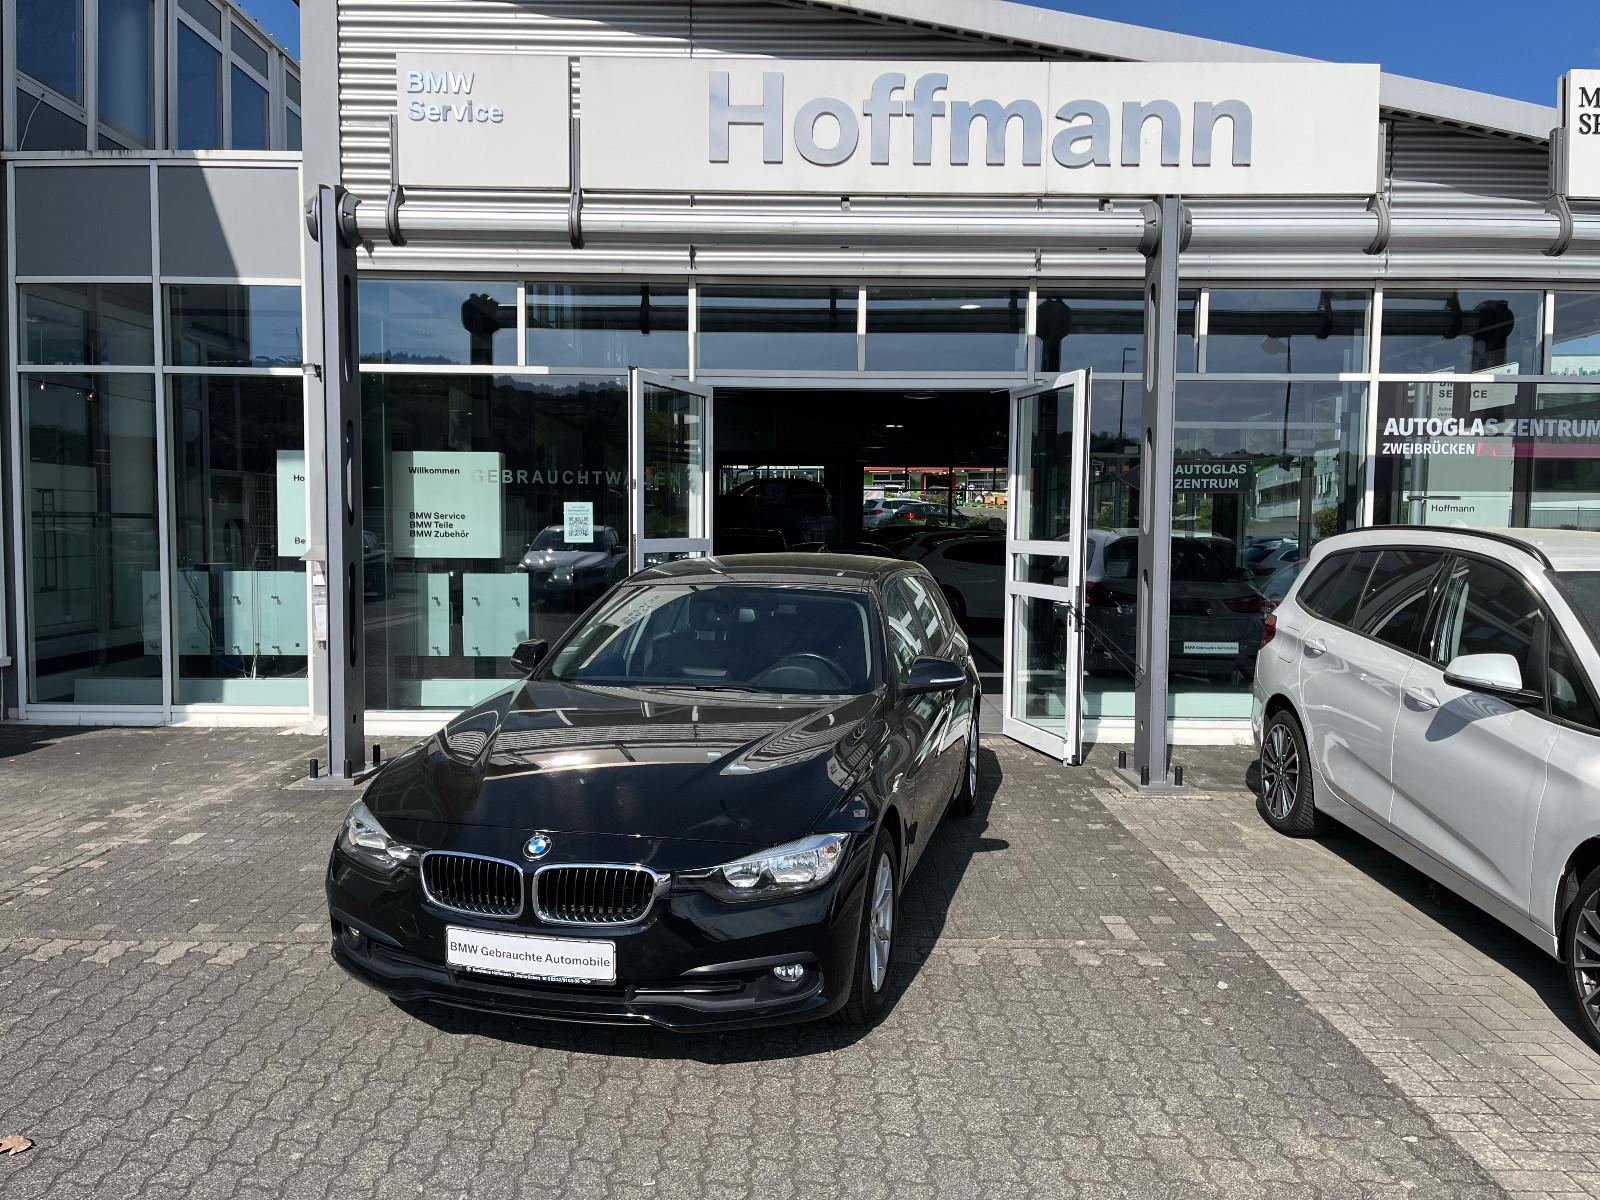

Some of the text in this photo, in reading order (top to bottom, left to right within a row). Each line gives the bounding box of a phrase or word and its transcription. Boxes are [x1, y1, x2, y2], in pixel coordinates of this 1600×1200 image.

[406, 70, 475, 94] BMW
[408, 100, 504, 123] Service
[708, 71, 1253, 168] Hoffmann
[1383, 417, 1600, 437] AUTOGLAS ZENTRUM
[1382, 440, 1475, 454] ZWEIBRÜCKEN
[408, 466, 460, 475] Willkommen
[1174, 464, 1247, 475] AUTOGLAS
[1174, 478, 1239, 489] ZENTRUM
[1431, 504, 1475, 513] Hoffmann
[409, 511, 466, 520] BMW Service
[409, 521, 454, 529] BMW Teile
[409, 530, 470, 538] BMW Zubehör
[450, 941, 611, 967] BMW Gebrauchte Automobile
